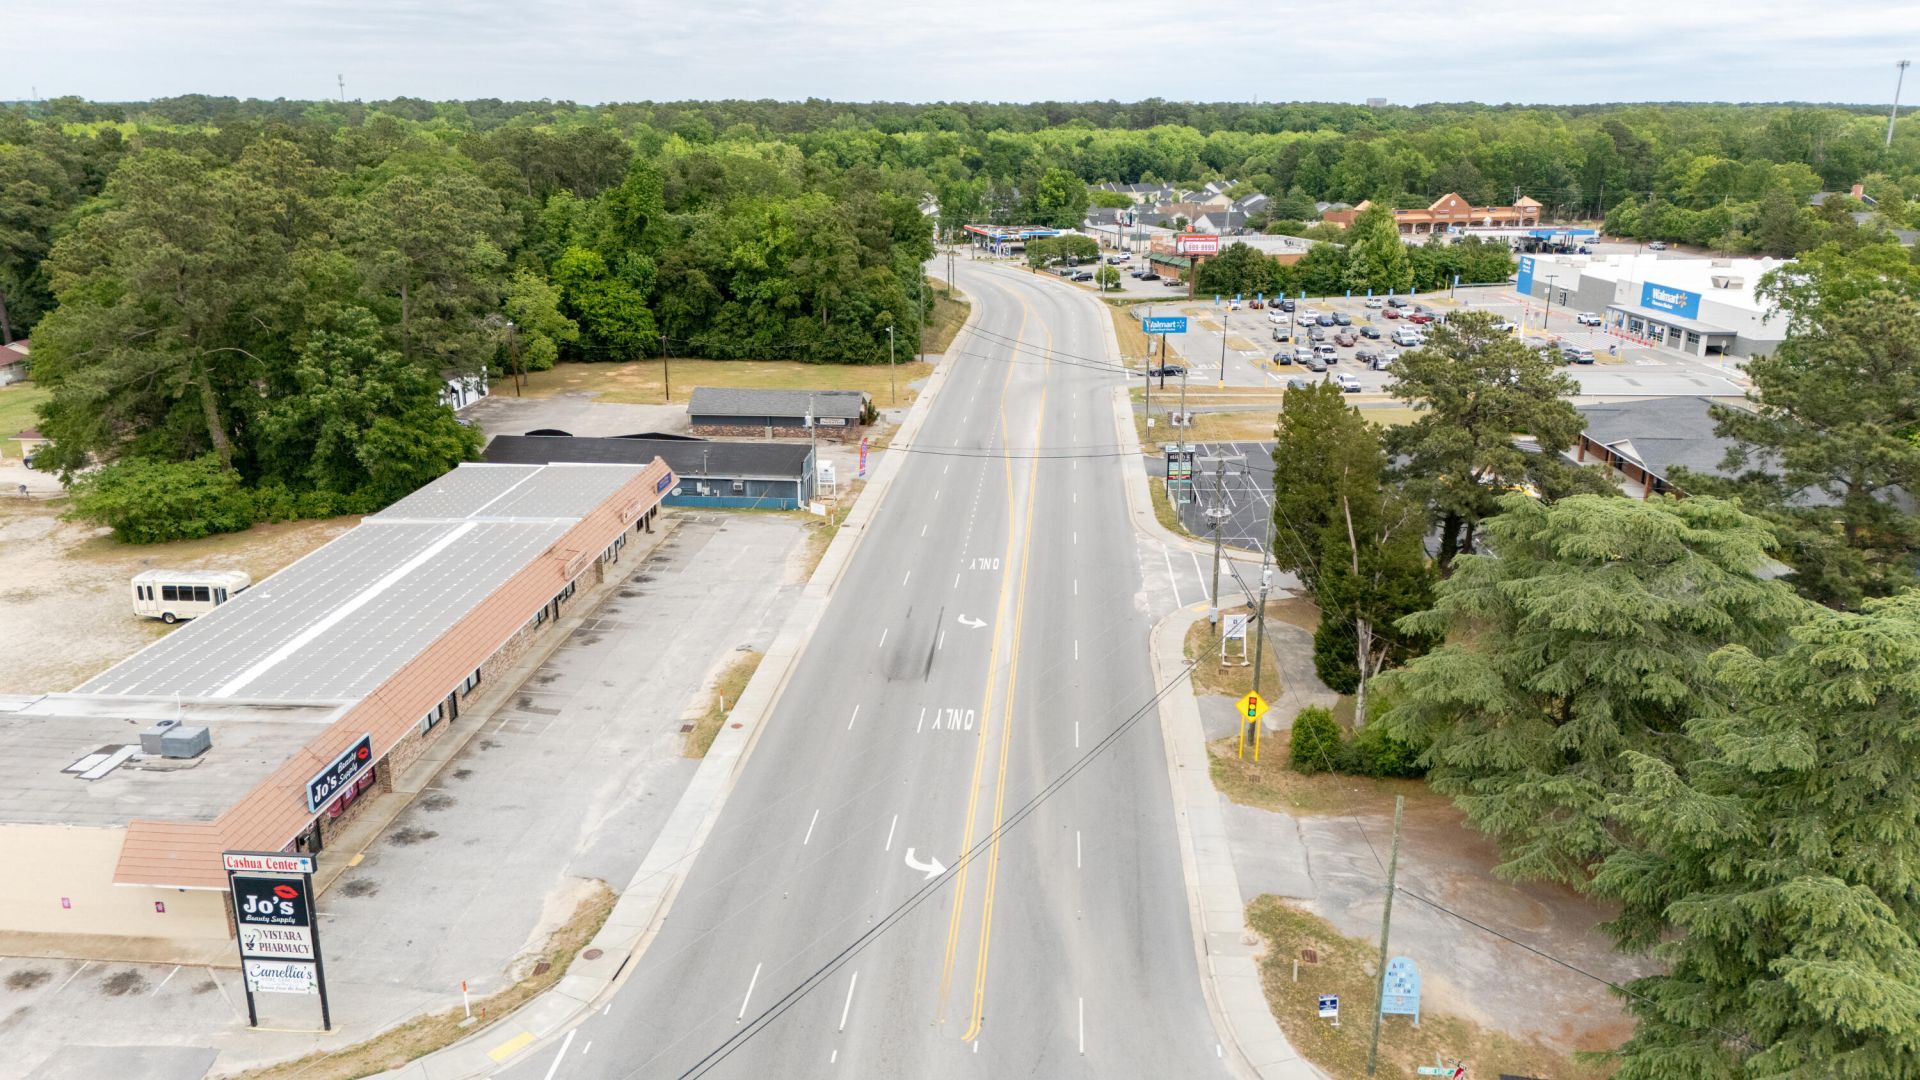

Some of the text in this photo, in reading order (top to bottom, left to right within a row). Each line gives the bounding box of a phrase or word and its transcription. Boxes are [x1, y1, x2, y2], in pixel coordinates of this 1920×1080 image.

[1652, 287, 1679, 305] Walmart
[968, 557, 1000, 570] ONLY
[931, 708, 975, 731] ONLY
[337, 751, 357, 774] Beauty
[314, 762, 358, 803] Jo's Supply
[226, 855, 299, 871] Cashua Center
[243, 894, 295, 916] Jo's
[245, 914, 296, 925] Beauty Supply
[262, 929, 303, 941] VISTARA
[259, 942, 310, 954] PHARMACY
[250, 963, 313, 980] Camellia's
